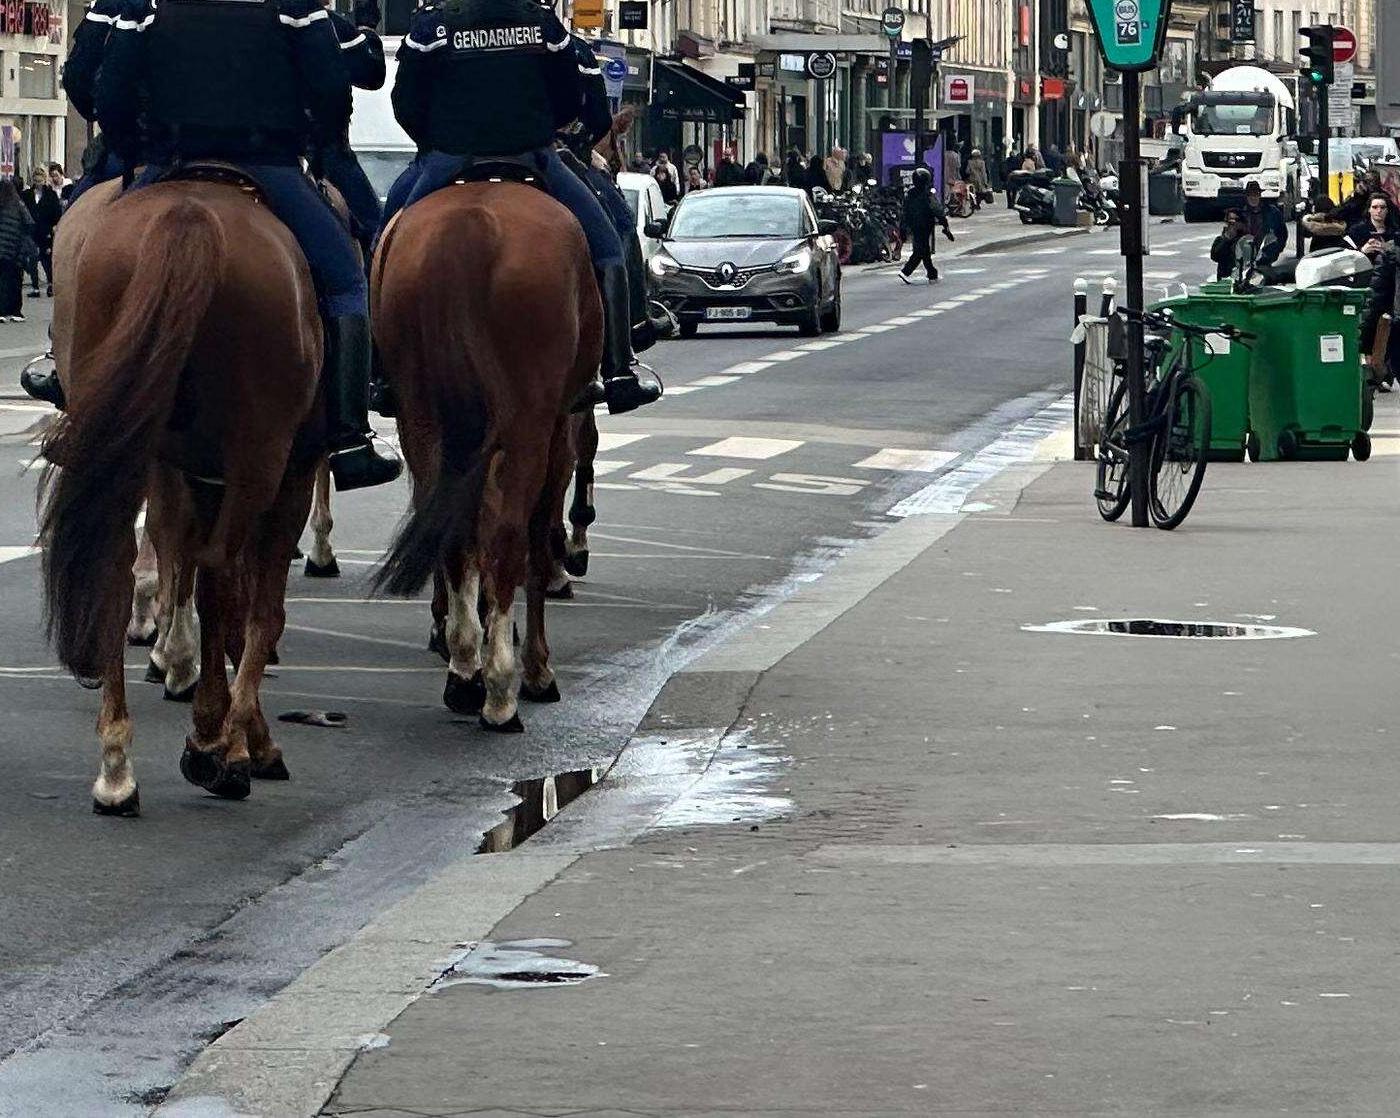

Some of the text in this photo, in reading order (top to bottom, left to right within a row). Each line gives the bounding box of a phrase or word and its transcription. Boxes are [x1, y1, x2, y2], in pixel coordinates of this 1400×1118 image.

[885, 13, 903, 23] BUS
[1118, 22, 1138, 36] 76
[453, 25, 544, 50] GENDARMERIE
